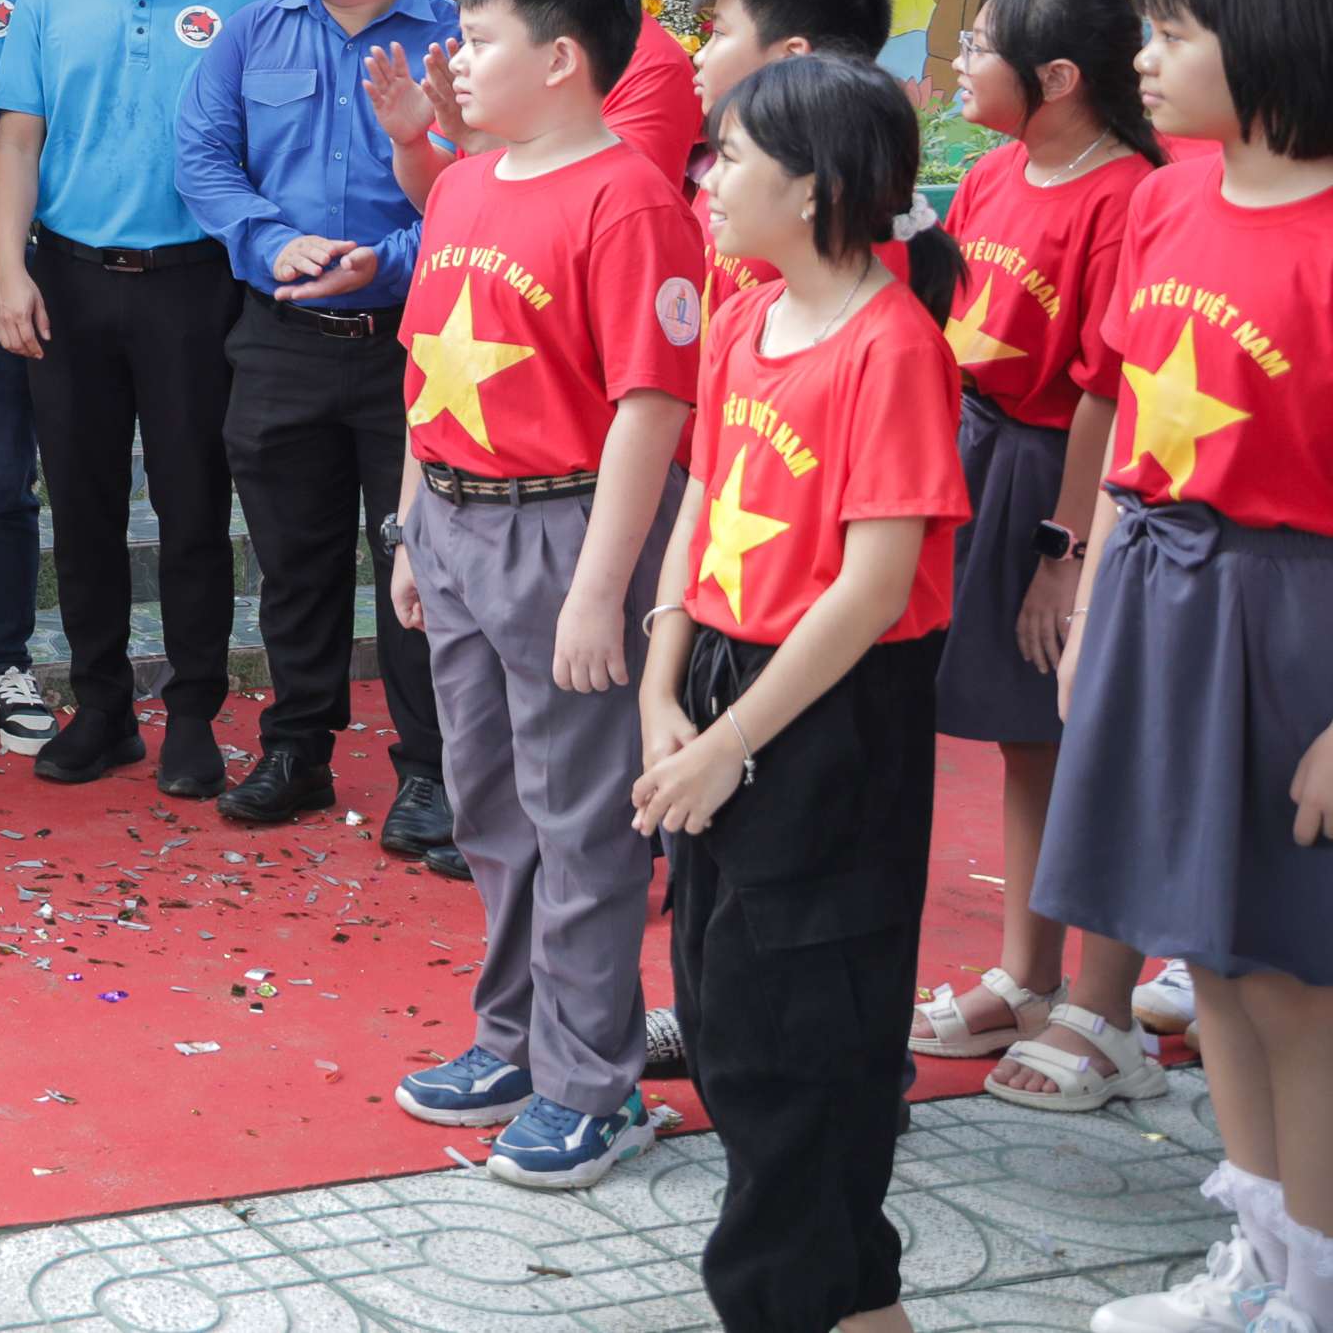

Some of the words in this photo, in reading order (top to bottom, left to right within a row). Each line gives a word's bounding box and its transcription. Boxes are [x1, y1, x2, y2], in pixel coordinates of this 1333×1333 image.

[431, 243, 464, 272] YÊU
[469, 245, 506, 274] VIỆT
[505, 266, 553, 311] NAM
[966, 236, 996, 262] YÊU
[993, 243, 1027, 277] VIỆT
[1021, 270, 1061, 320] NAM
[1150, 277, 1190, 307] YÊU
[1192, 287, 1239, 329] VIỆT
[1233, 320, 1292, 378] NAM
[749, 398, 778, 438] VIỆT
[770, 421, 820, 479] NAM
